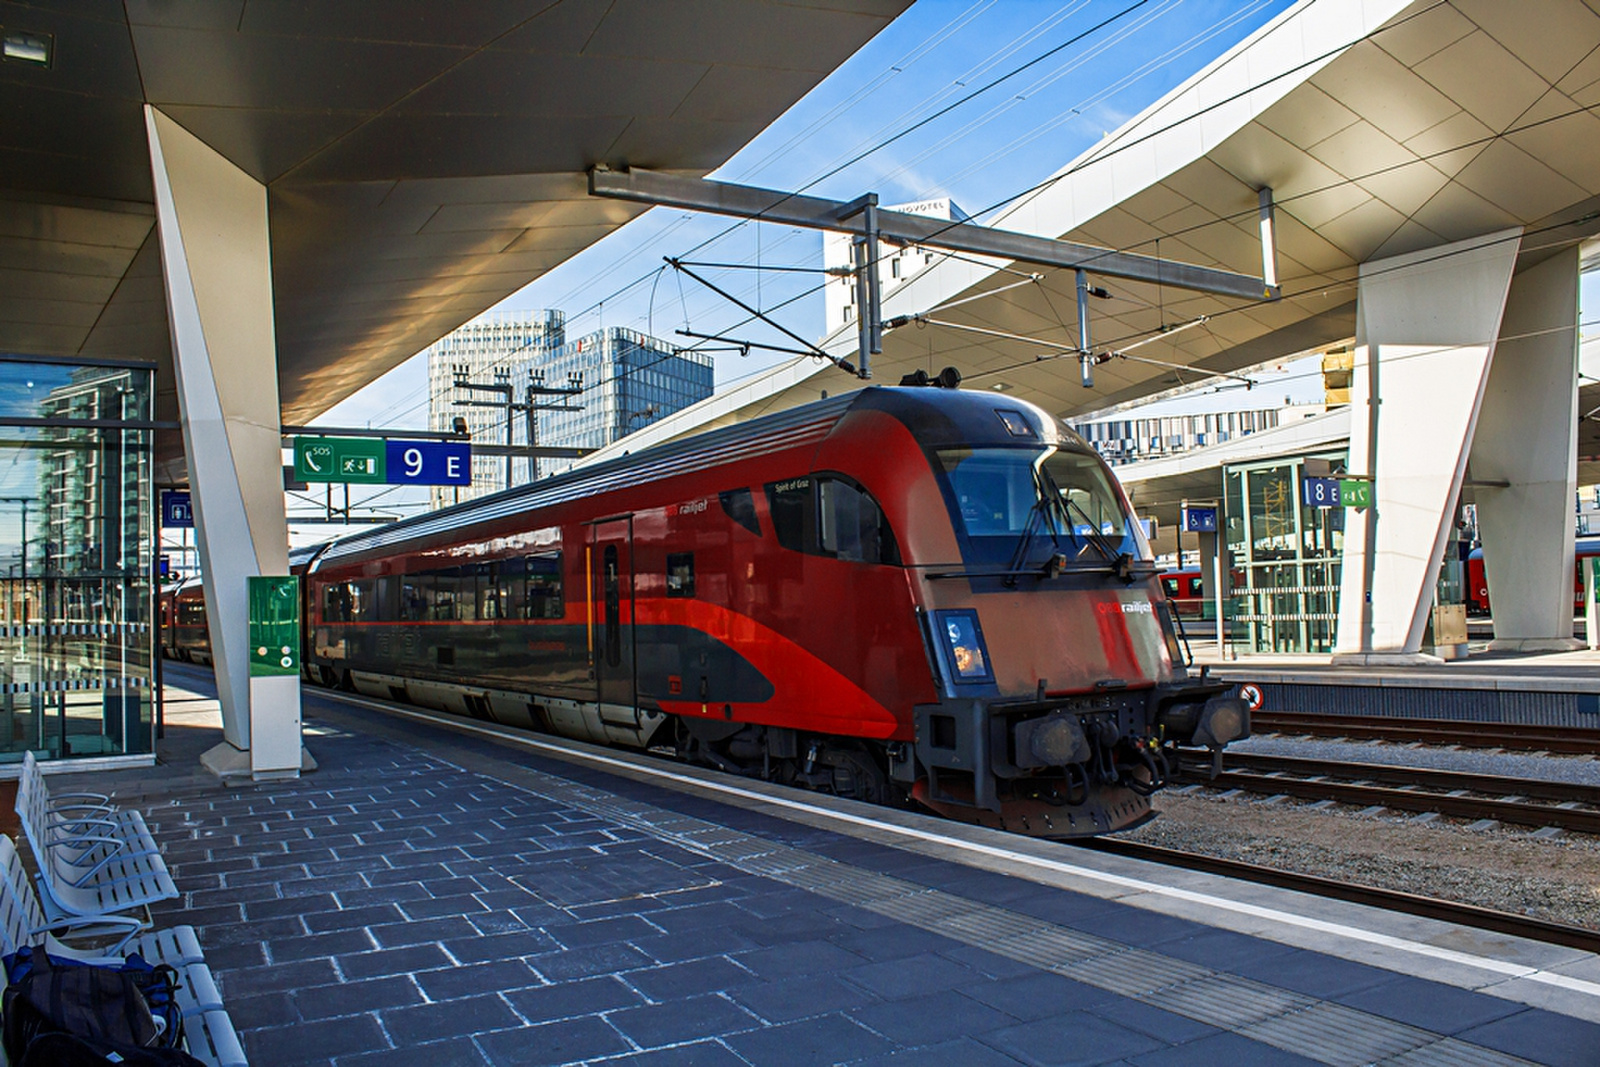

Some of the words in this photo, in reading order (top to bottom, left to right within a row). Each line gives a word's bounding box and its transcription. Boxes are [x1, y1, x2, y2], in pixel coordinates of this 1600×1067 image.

[898, 202, 944, 214] NOVOTEL
[313, 447, 331, 456] SOS
[404, 448, 424, 477] 9
[447, 456, 461, 477] E
[775, 483, 789, 494] Spirit
[790, 481, 796, 490] of
[1315, 483, 1325, 501] 8
[1331, 487, 1338, 502] E
[679, 499, 708, 515] railjet
[1121, 600, 1152, 614] railjet
